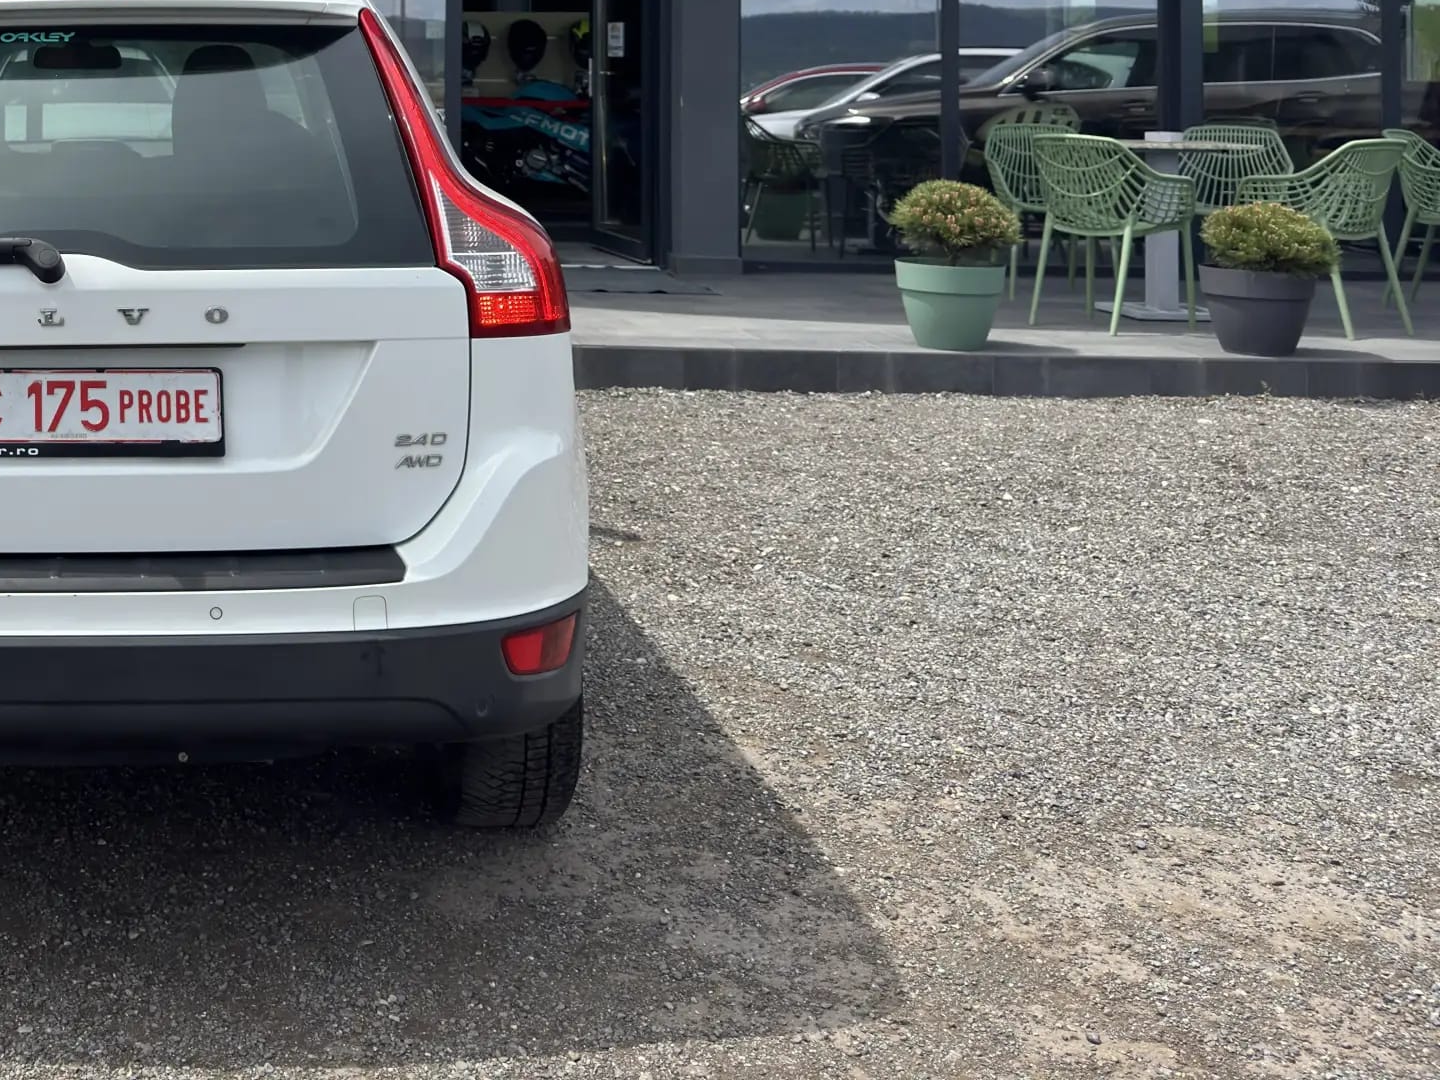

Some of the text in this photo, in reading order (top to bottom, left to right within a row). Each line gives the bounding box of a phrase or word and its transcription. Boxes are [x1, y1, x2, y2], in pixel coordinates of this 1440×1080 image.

[0, 31, 76, 43] OAKLEY
[27, 380, 110, 433] 175
[119, 389, 209, 423] PROBE
[394, 454, 443, 469] AWD
